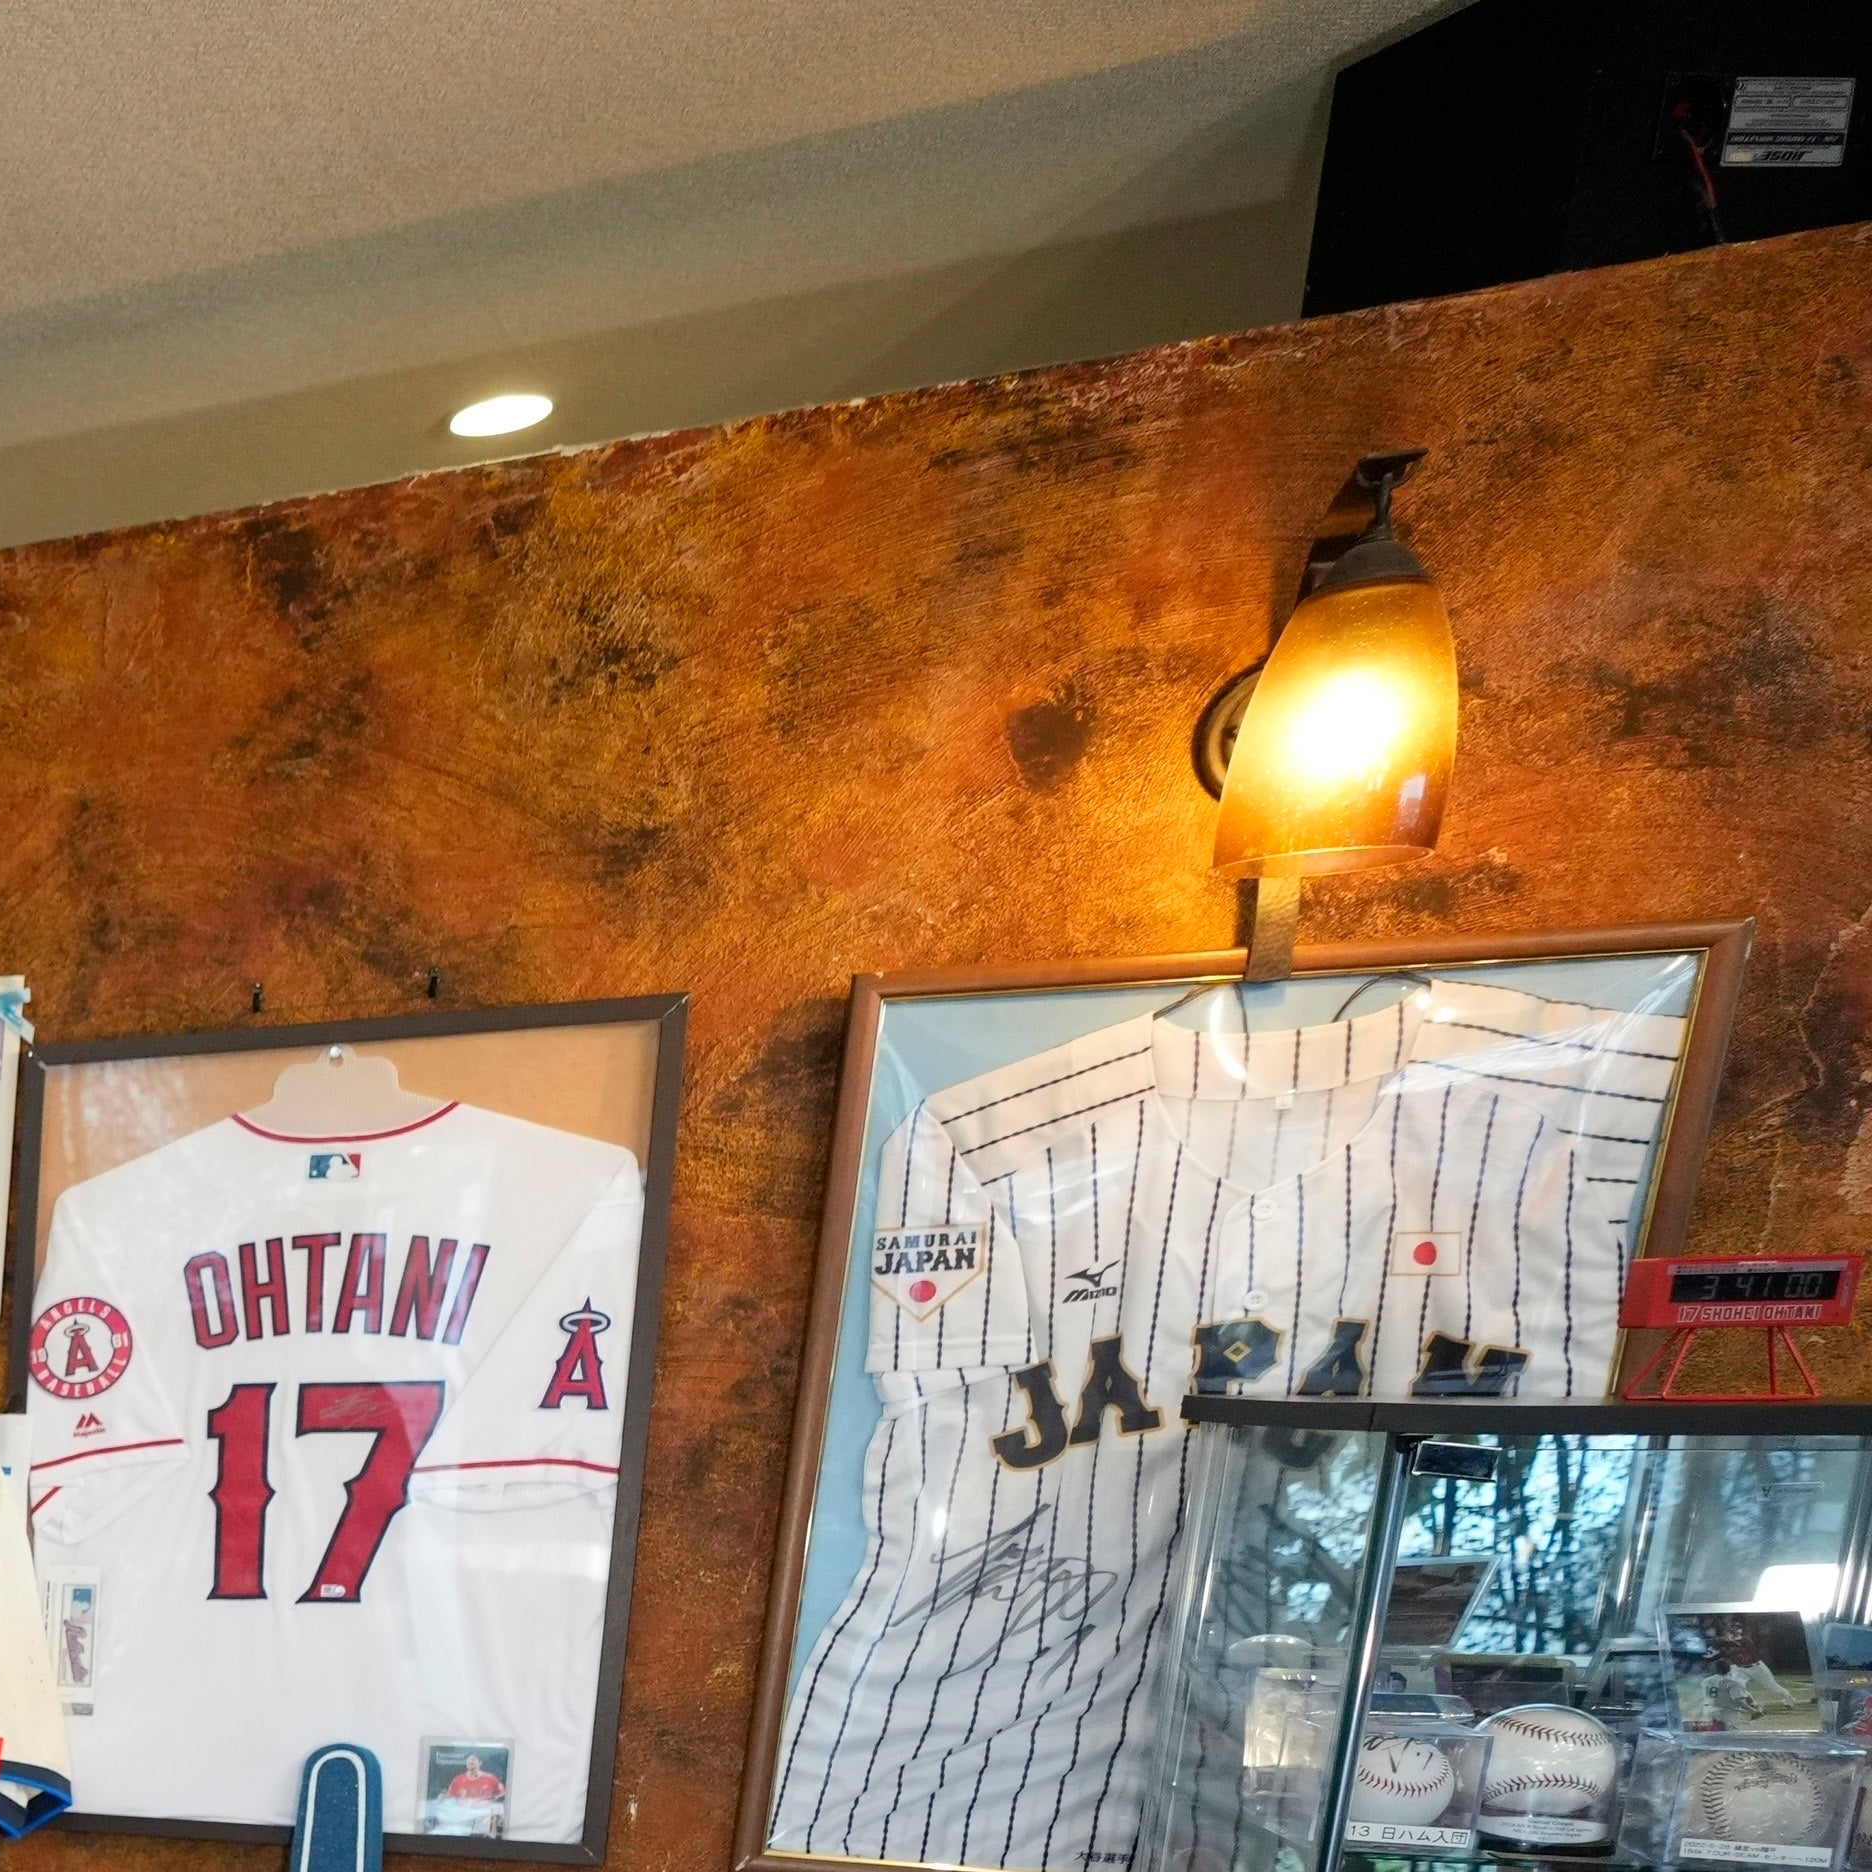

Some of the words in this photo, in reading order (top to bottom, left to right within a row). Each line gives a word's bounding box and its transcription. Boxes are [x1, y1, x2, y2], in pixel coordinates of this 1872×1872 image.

[875, 1227, 981, 1252] SAMURAI
[873, 1243, 978, 1276] JAPAN
[182, 1231, 492, 1351] OHTANI
[38, 1298, 114, 1333] ANGELS
[1677, 1306, 1699, 1323] 17
[1700, 1305, 1760, 1321] SHOHEI
[1763, 1304, 1823, 1320] OHTANI
[537, 1295, 610, 1411] A
[36, 1362, 130, 1399] BASEBALL
[207, 1380, 447, 1604] 17
[1379, 1825, 1469, 1847] 日ハム入団
